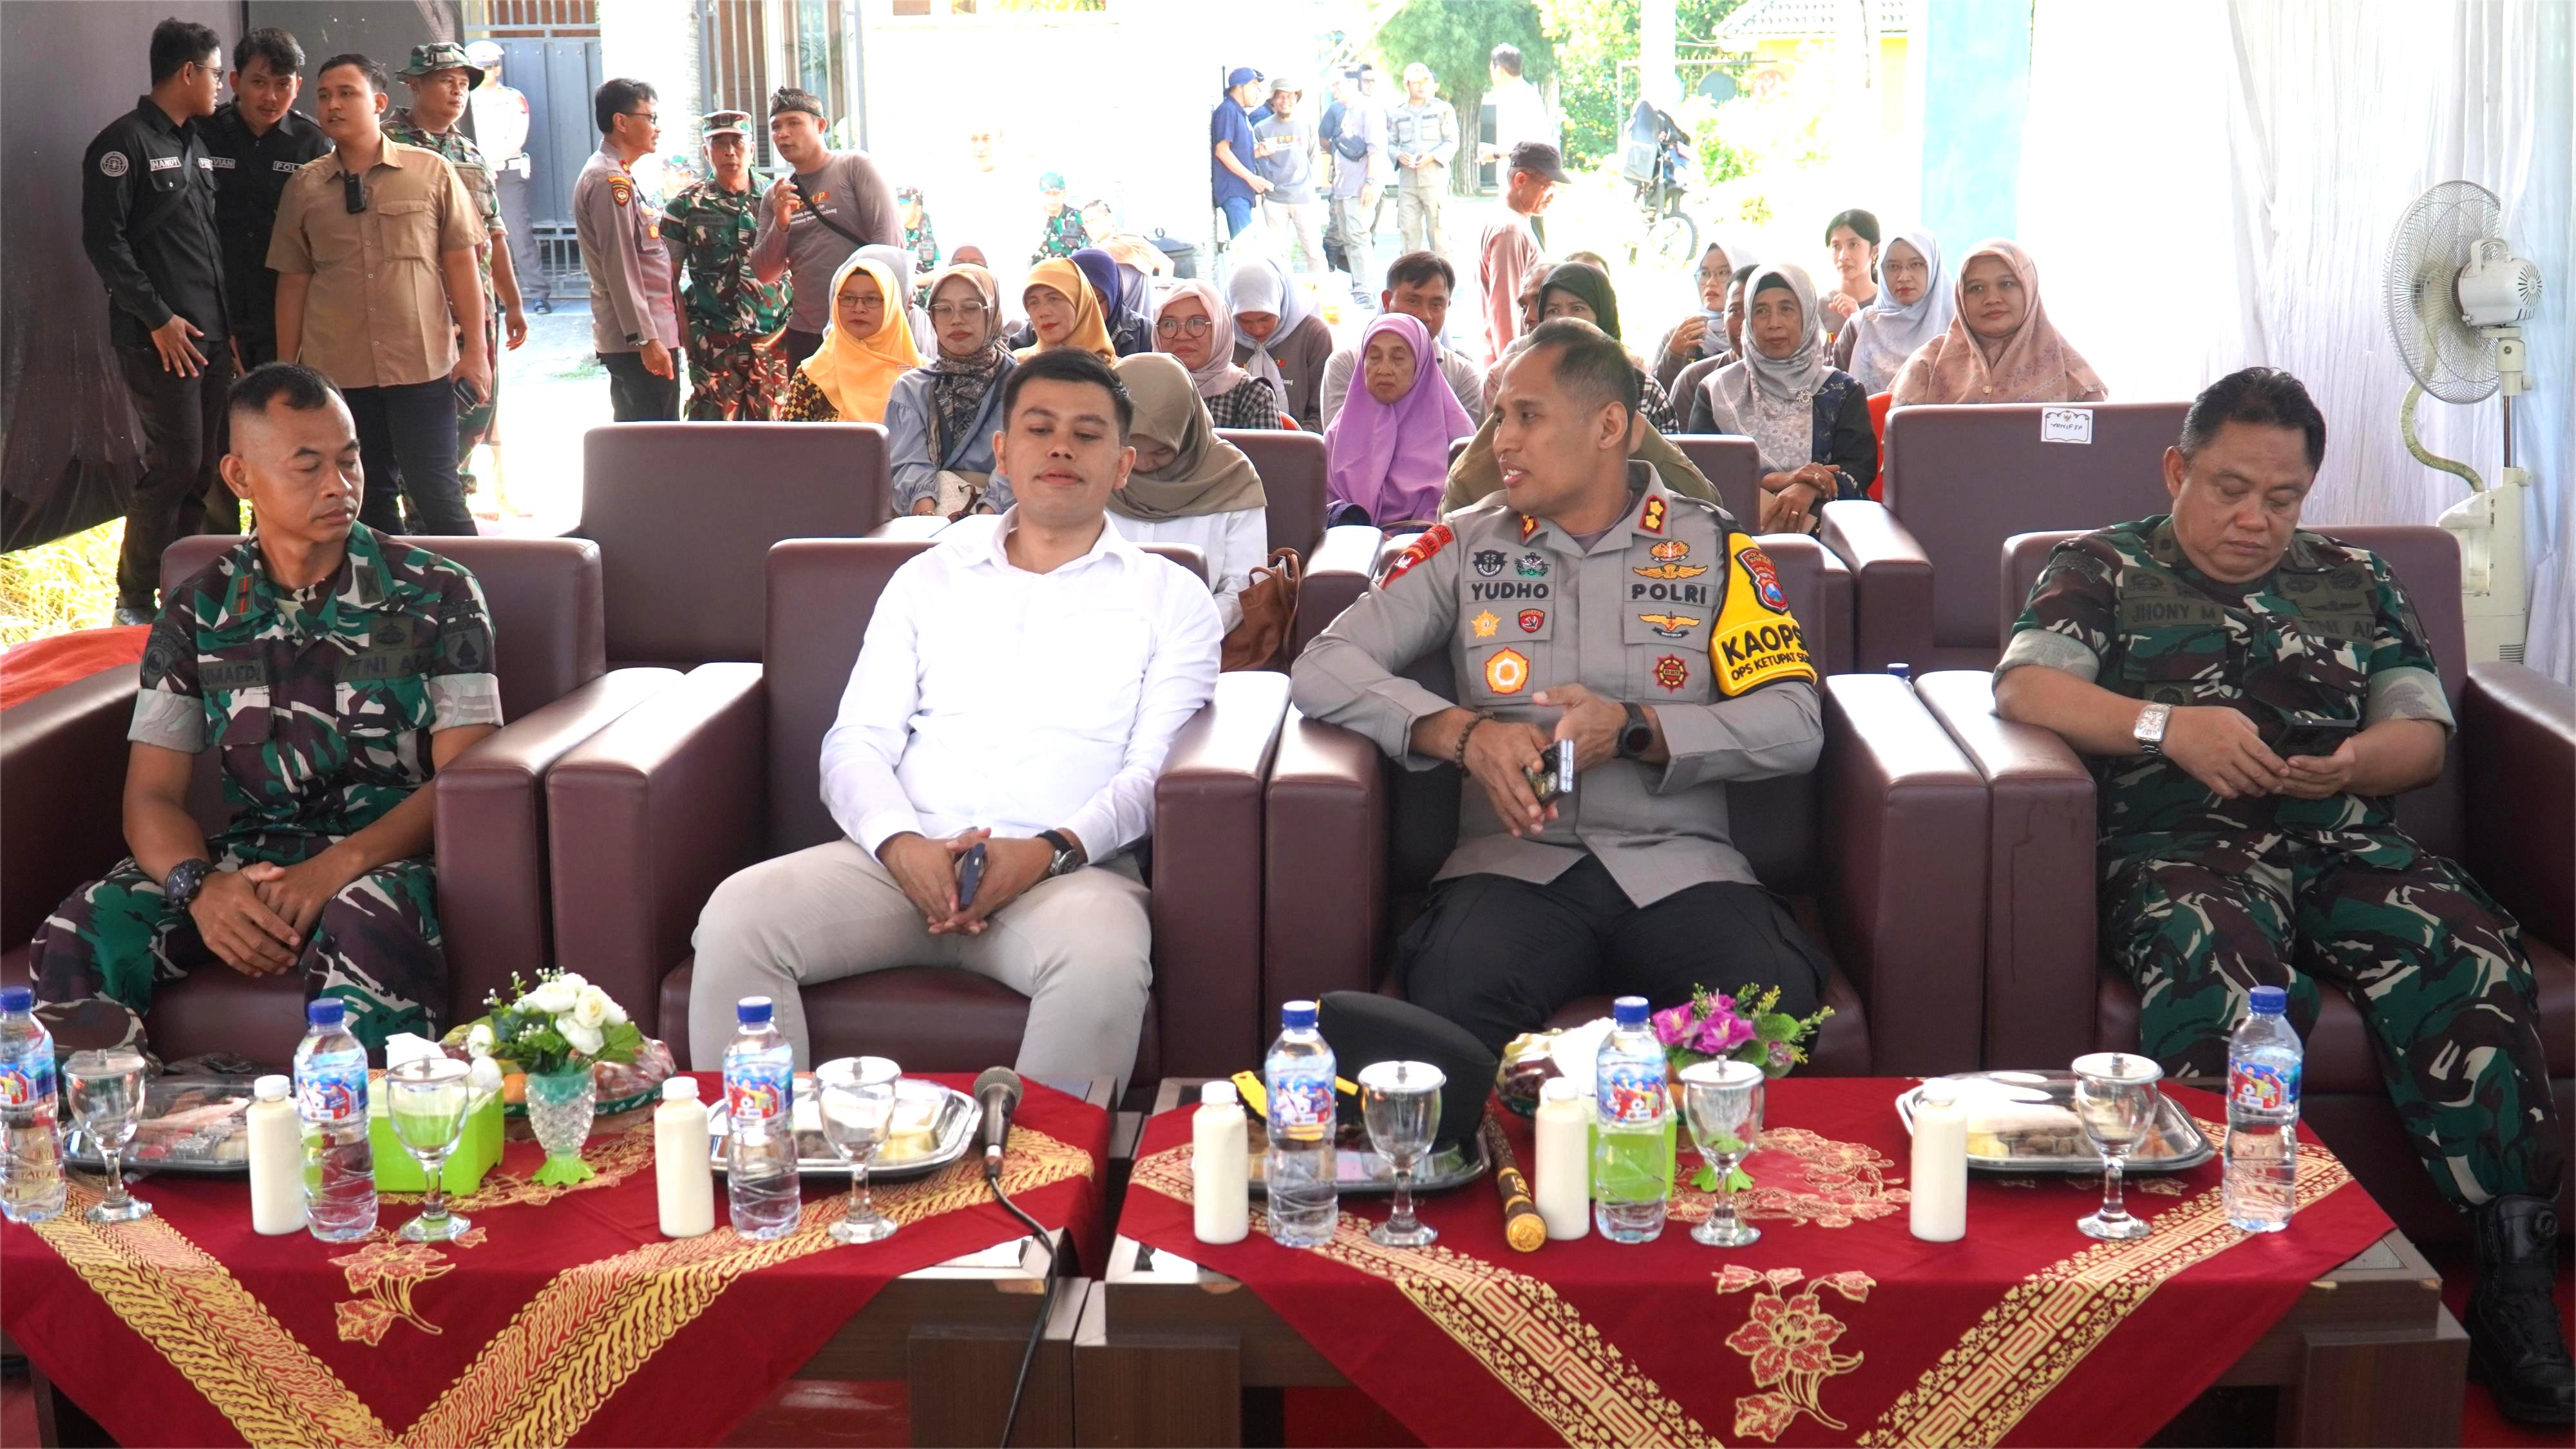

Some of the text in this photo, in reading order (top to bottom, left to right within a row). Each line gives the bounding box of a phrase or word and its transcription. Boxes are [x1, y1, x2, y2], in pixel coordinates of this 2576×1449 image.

[152, 158, 180, 169] HANDY
[1472, 582, 1549, 601] YUDHO
[1632, 583, 1707, 604] POLRI
[2132, 602, 2216, 623] JHONY M
[1721, 623, 1808, 667] KAOPS
[350, 656, 387, 675] TNI
[1731, 663, 1754, 681] OPS
[1753, 652, 1796, 670] KETUPAT
